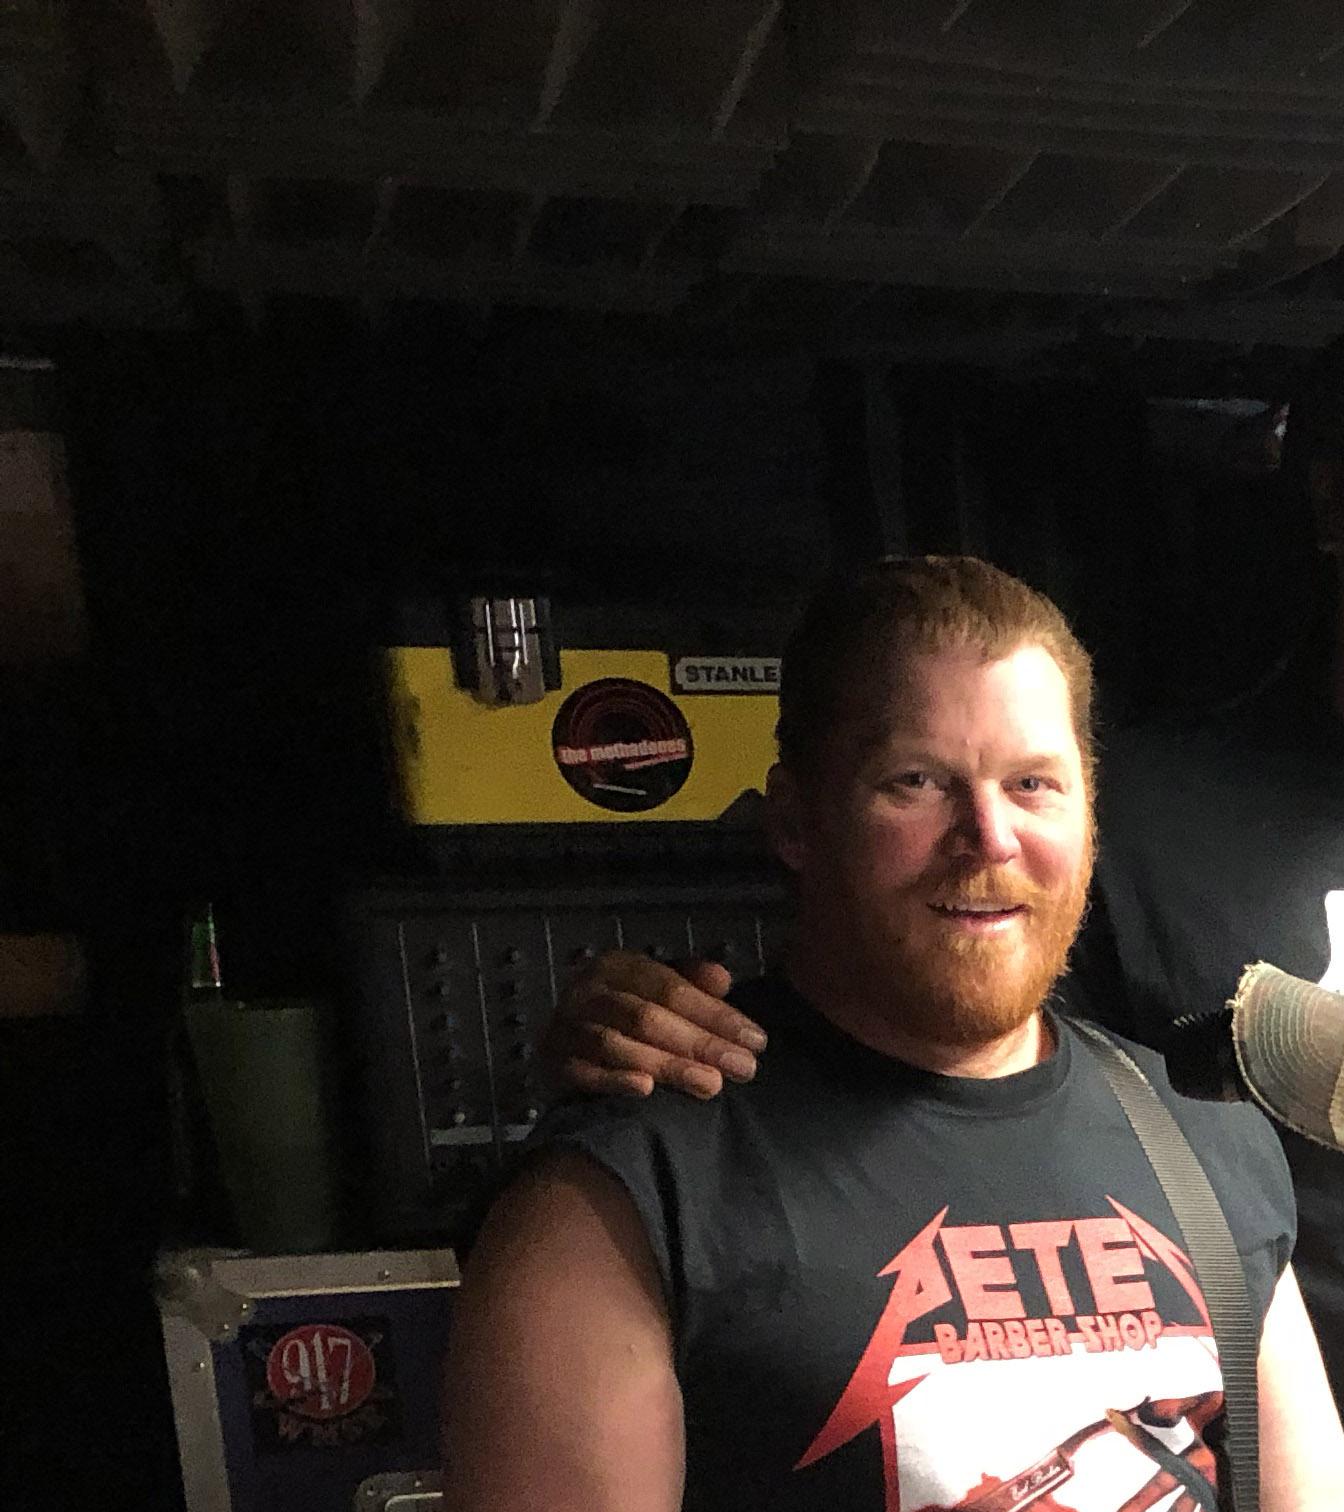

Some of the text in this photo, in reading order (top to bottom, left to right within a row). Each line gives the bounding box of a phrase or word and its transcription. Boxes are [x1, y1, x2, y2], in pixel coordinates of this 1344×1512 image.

[685, 664, 779, 682] STANLE
[934, 1310, 1163, 1364] BARBER SHOP
